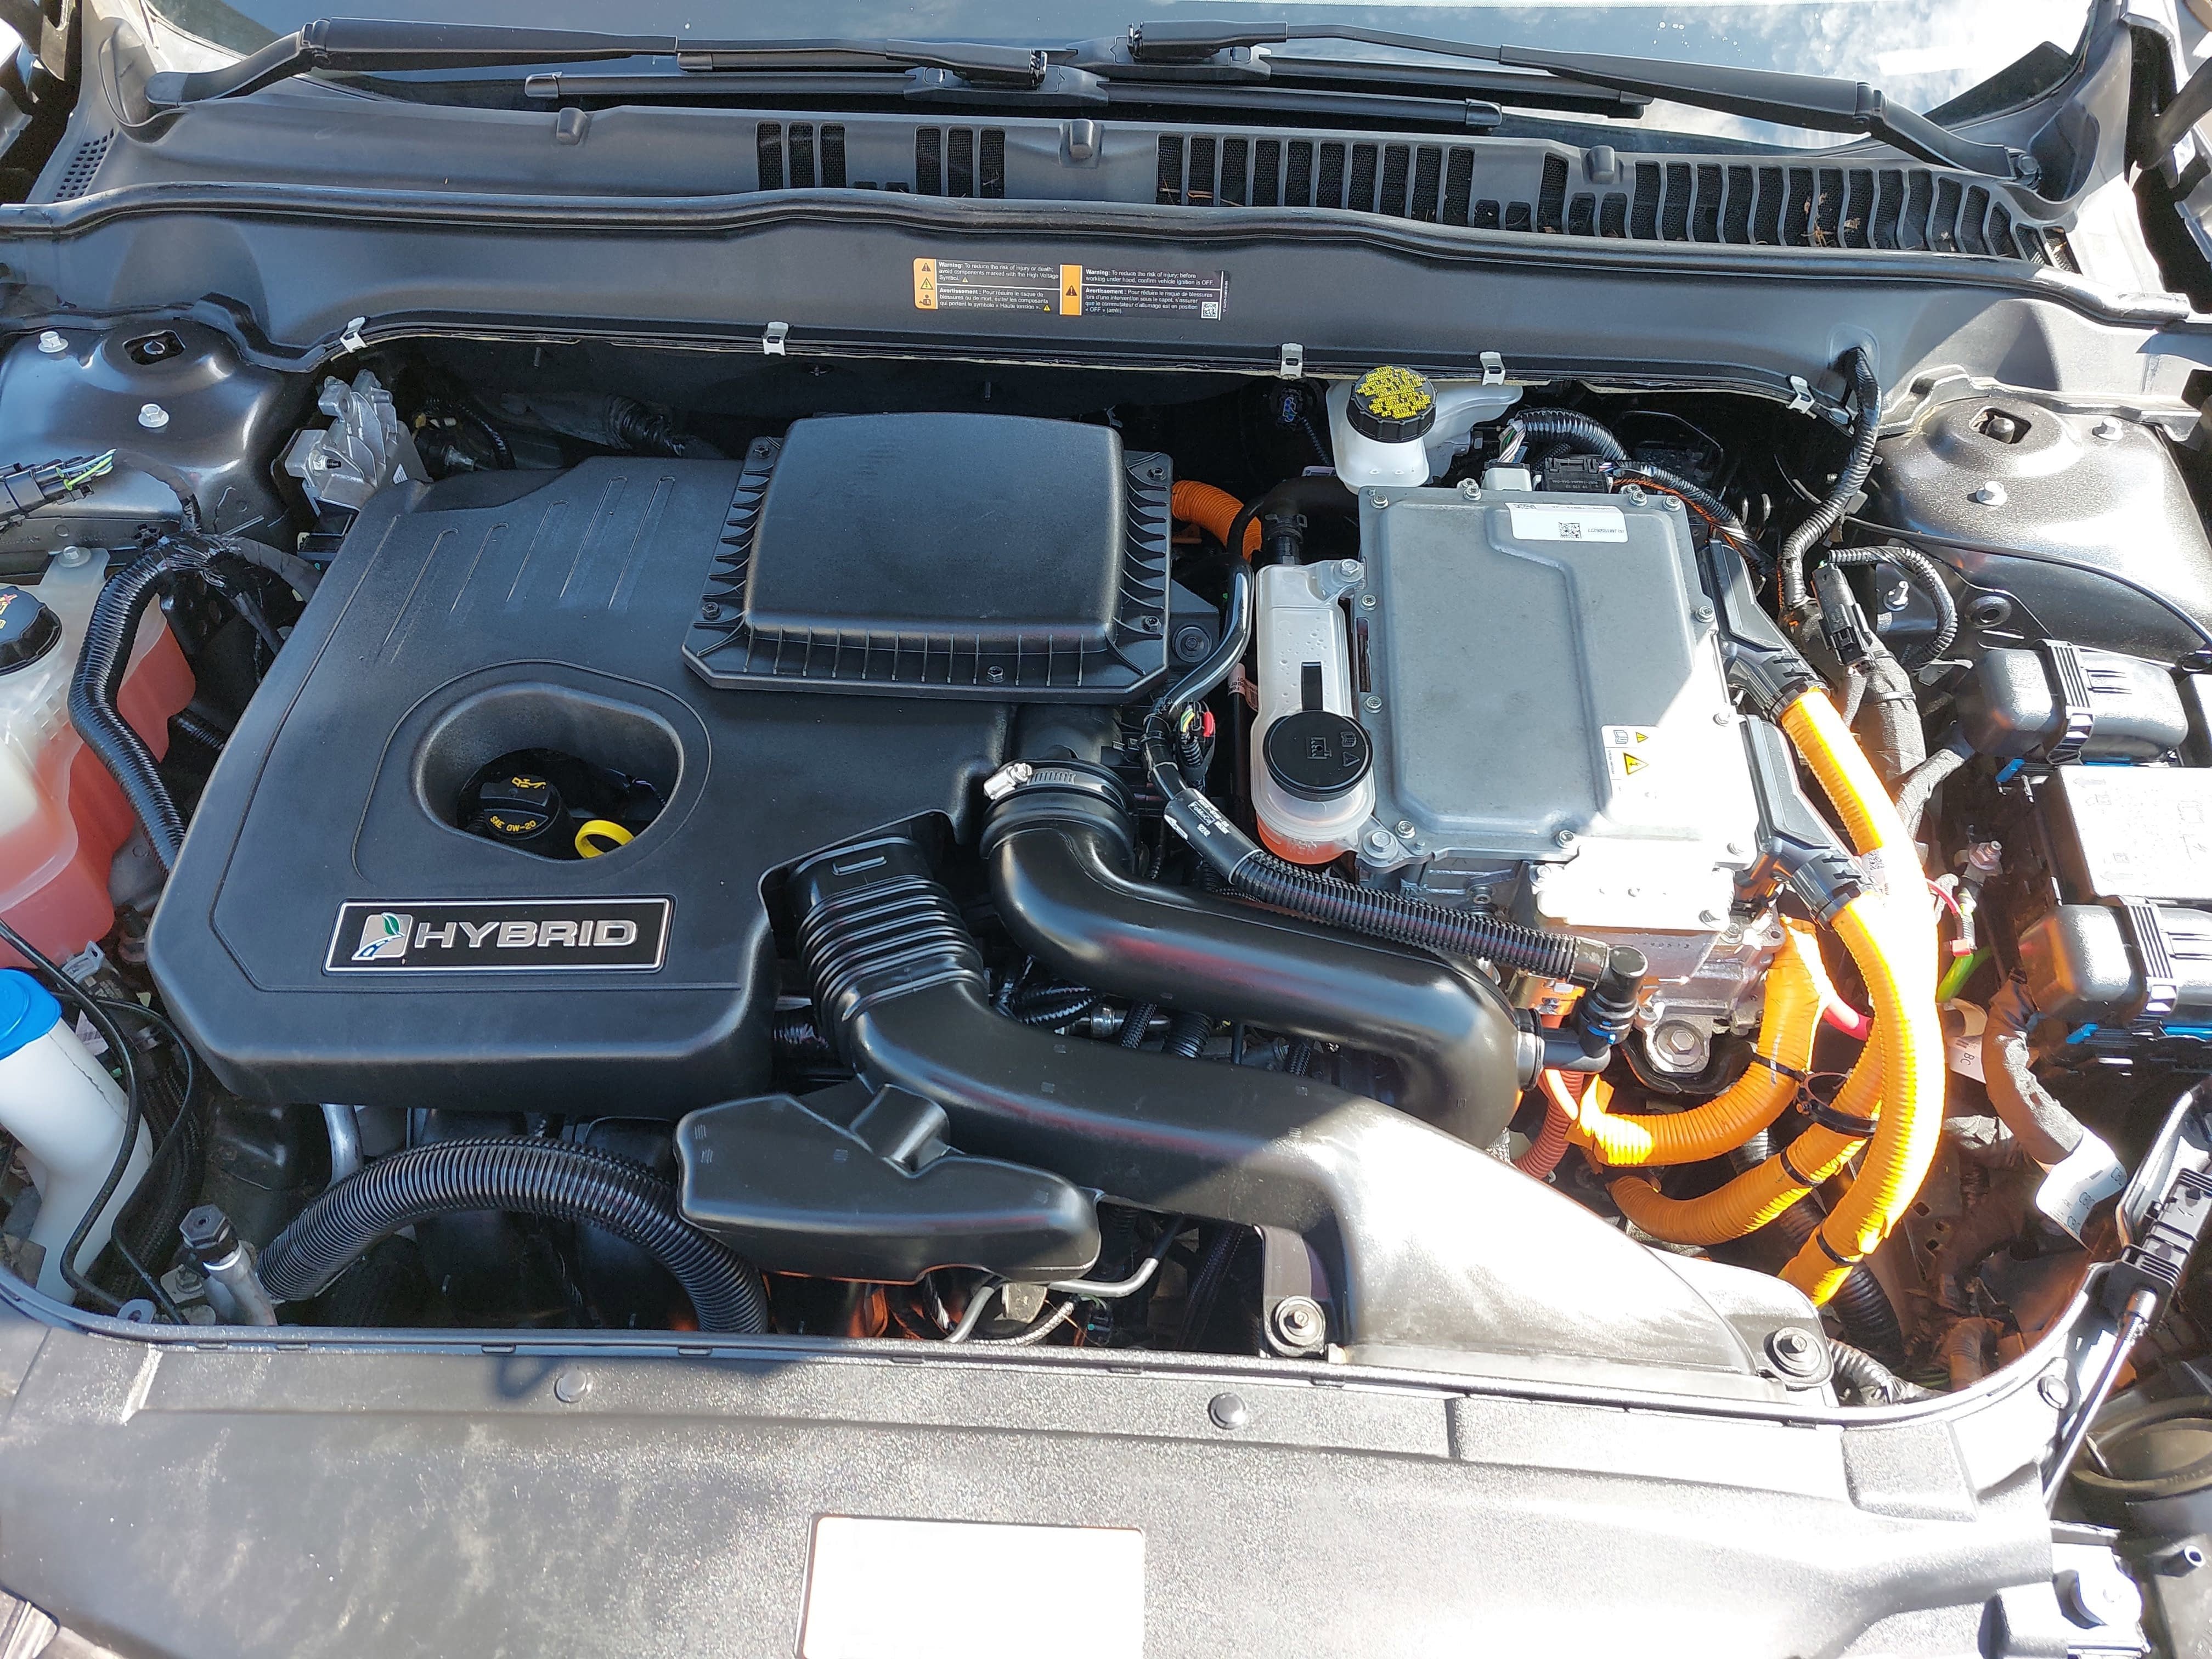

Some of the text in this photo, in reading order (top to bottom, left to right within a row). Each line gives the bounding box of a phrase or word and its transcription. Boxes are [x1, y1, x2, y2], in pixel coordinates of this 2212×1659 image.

[490, 815, 505, 830] SAE
[1190, 802, 1212, 824] FoMoCo
[414, 920, 638, 949] HYBRID
